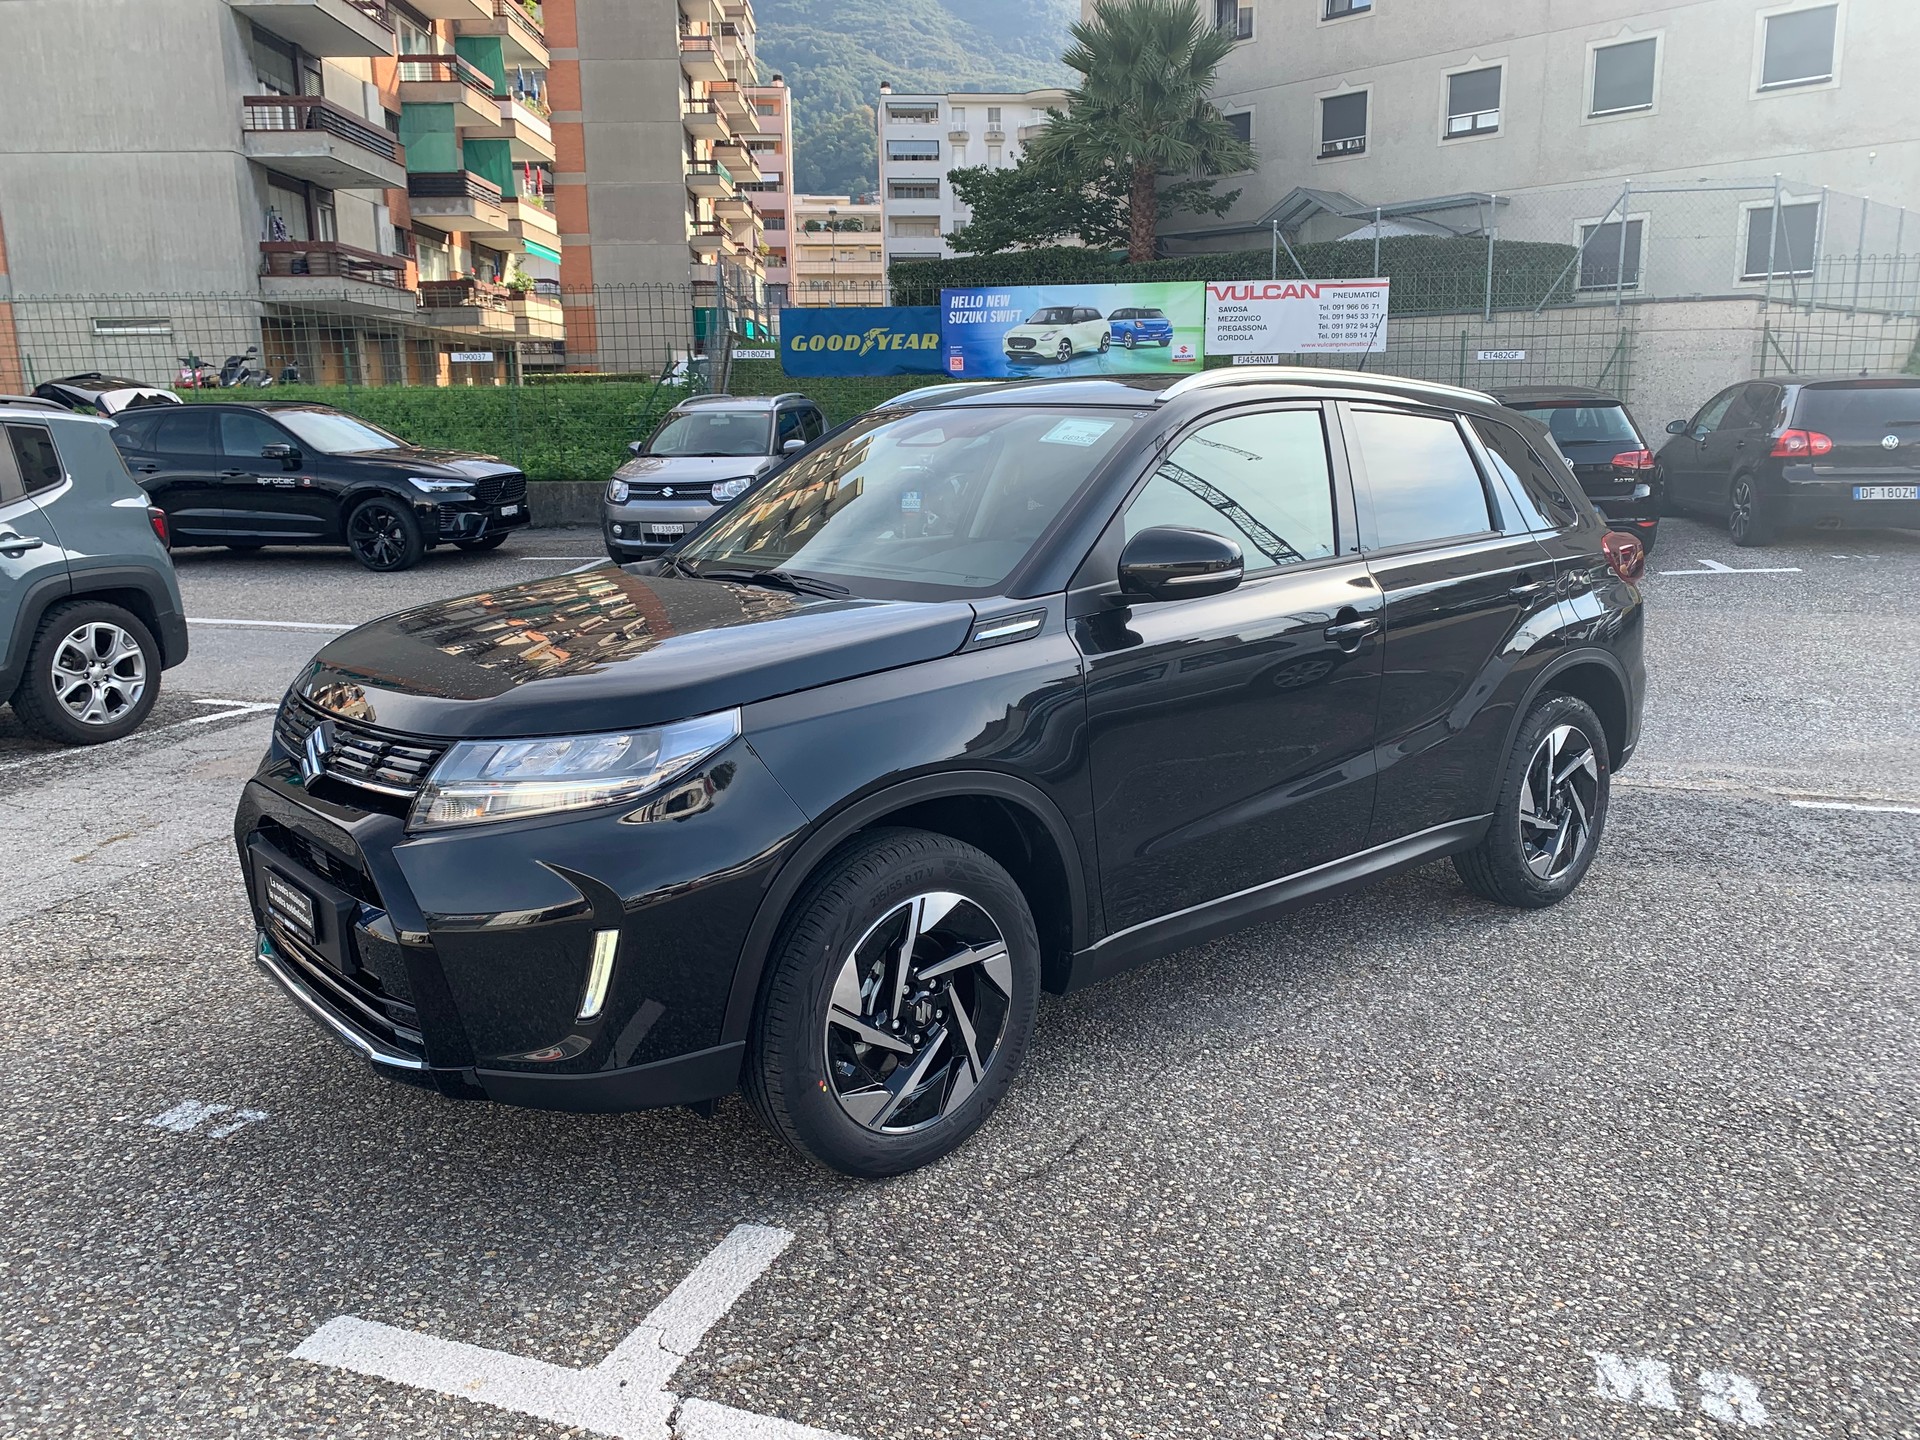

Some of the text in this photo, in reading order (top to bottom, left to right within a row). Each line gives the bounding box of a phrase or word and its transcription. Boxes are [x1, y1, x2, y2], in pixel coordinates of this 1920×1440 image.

[1209, 284, 1320, 301] VULCAN
[951, 294, 1011, 308] HELLO NEW
[949, 309, 1022, 324] SUZUKI SWIFT
[736, 350, 771, 358] DF180ZH
[1483, 351, 1519, 359] ET482GF
[256, 477, 295, 485] aprotec
[1862, 487, 1876, 499] DF
[1881, 487, 1916, 498] 180ZH
[869, 880, 902, 908] 215/55
[904, 874, 912, 885] R
[913, 869, 924, 881] 17
